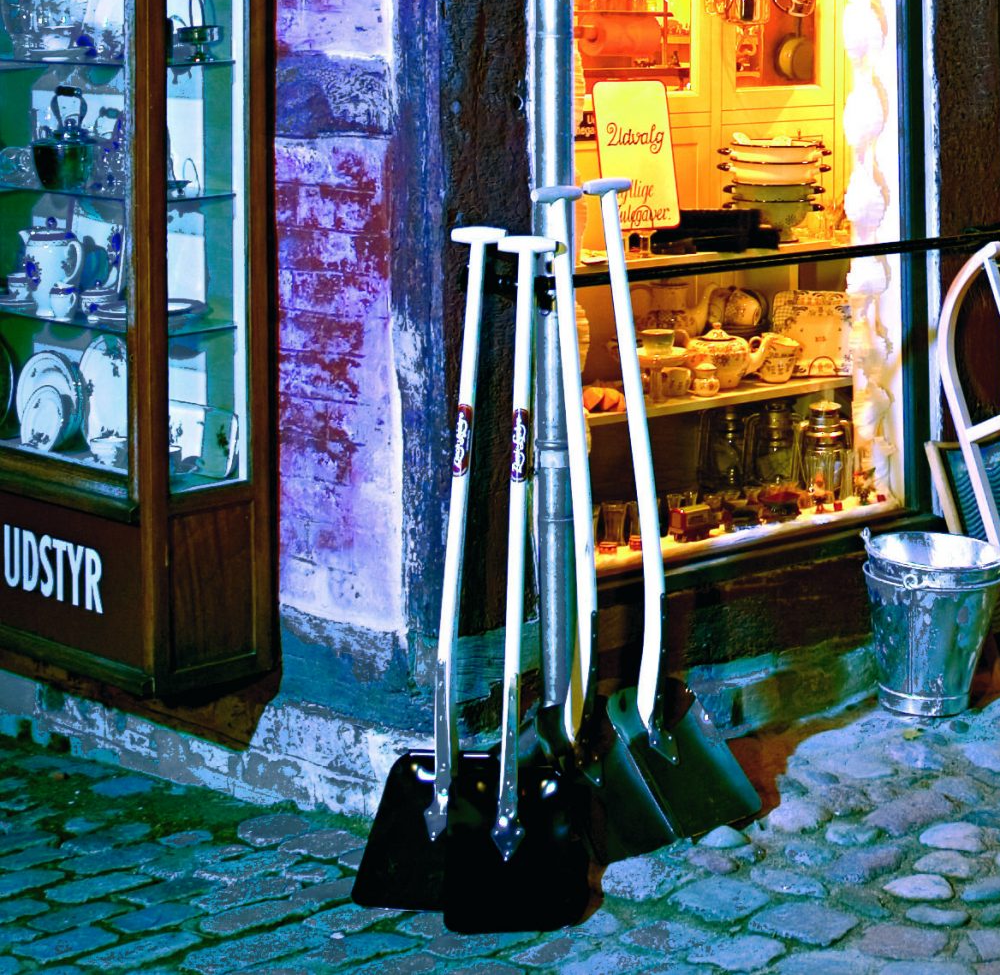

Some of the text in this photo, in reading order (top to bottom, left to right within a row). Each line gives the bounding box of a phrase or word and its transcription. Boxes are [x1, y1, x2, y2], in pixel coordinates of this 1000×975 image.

[606, 122, 665, 154] Udvalg
[618, 205, 672, 226] ulegaver.
[4, 524, 103, 614] UDSTYR
